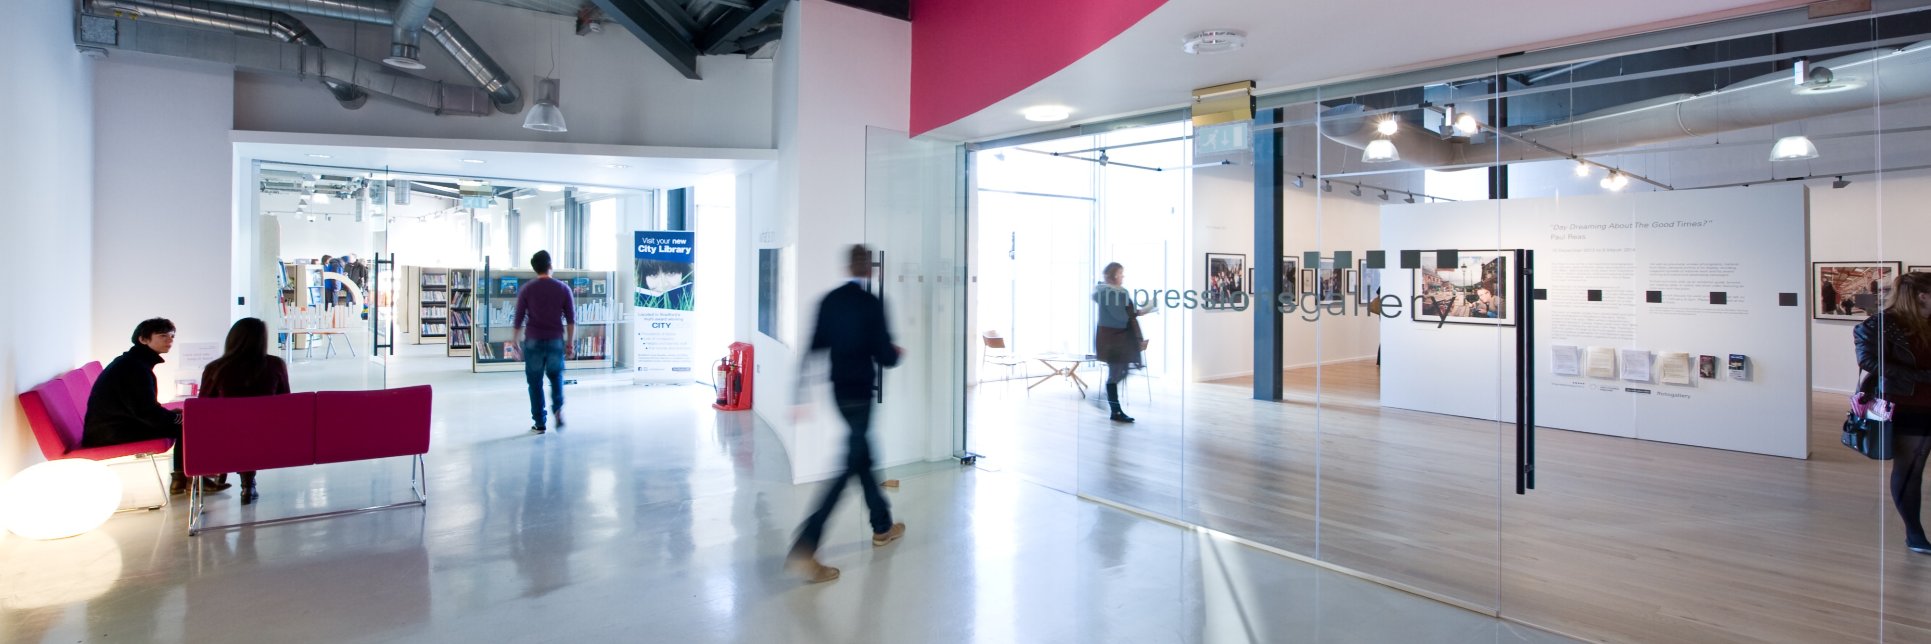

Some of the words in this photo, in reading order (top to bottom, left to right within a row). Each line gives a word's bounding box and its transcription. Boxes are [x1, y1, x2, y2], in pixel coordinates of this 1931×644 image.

[1569, 223, 1607, 231] Dreaming
[1635, 221, 1649, 229] The
[642, 237, 655, 245] Visit
[656, 238, 671, 246] your
[638, 245, 657, 255] City
[659, 245, 692, 255] Library
